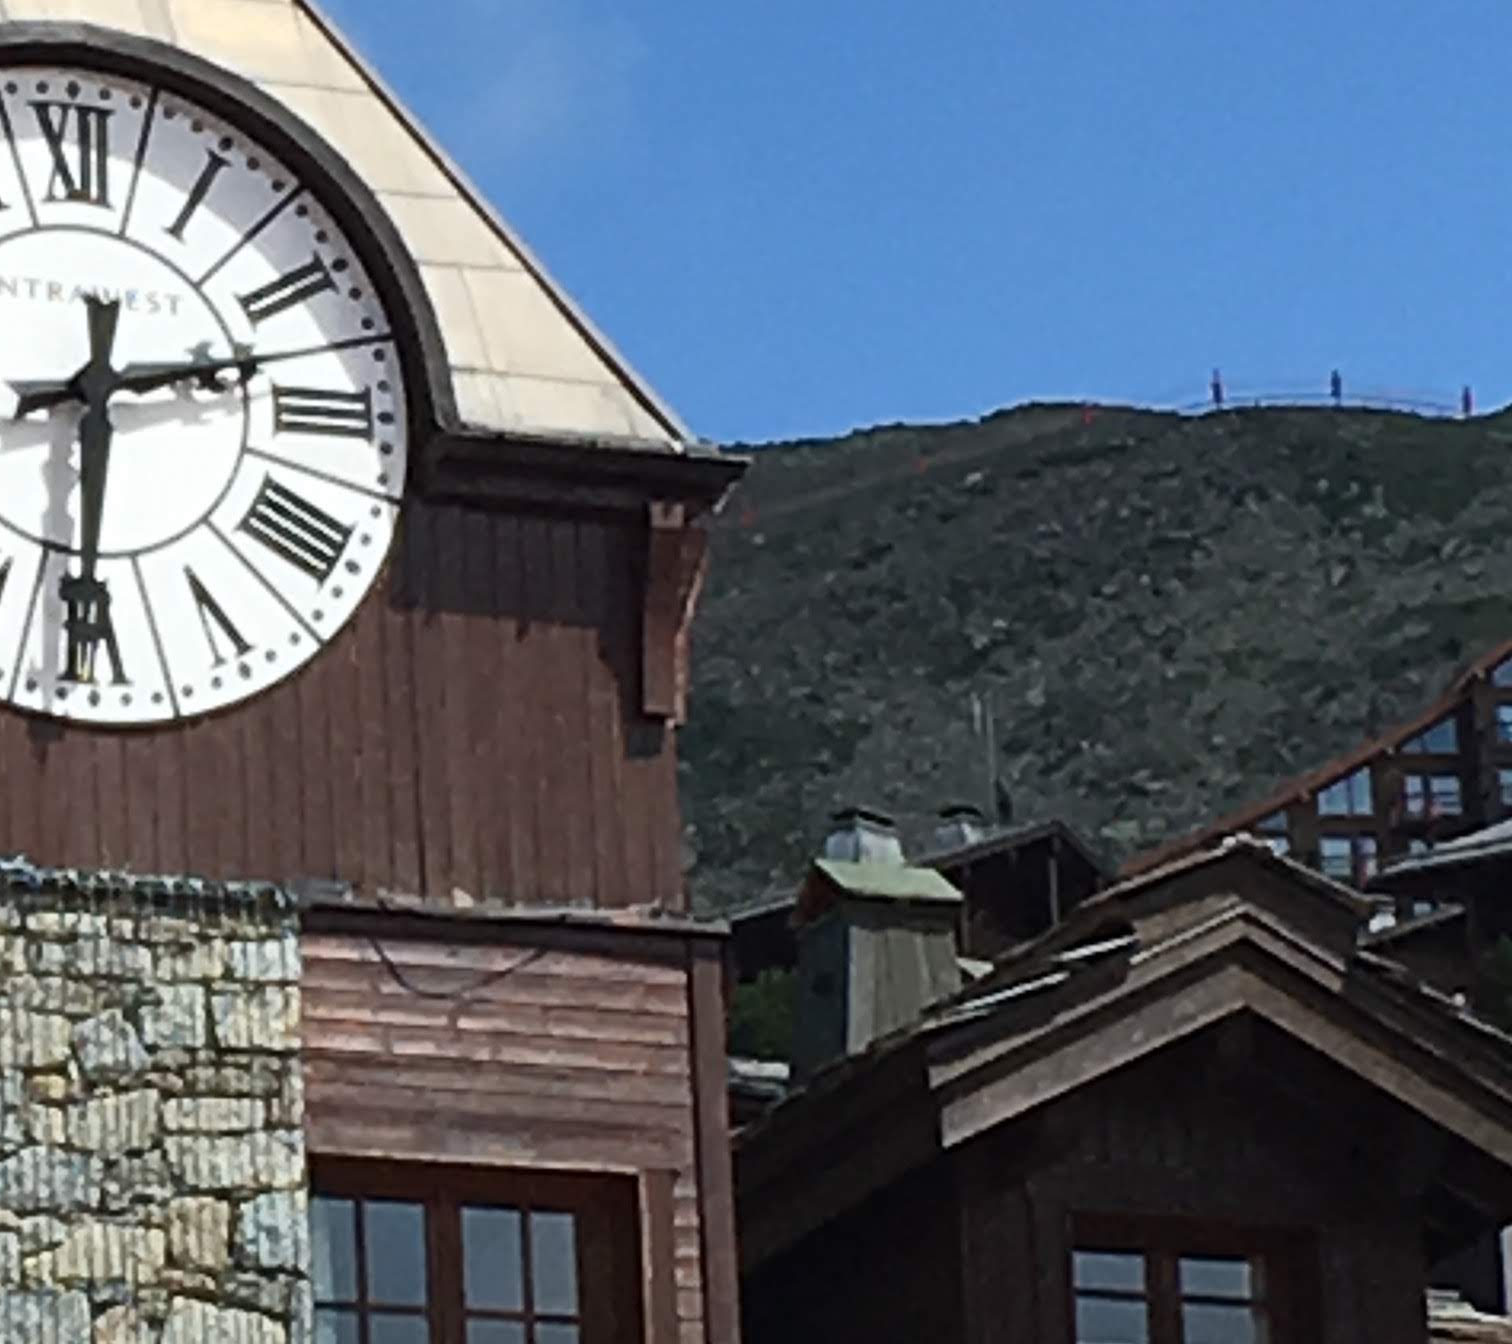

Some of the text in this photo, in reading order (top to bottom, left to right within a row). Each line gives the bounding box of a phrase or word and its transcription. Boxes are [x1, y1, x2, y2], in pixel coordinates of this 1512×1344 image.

[27, 101, 116, 211] XII
[164, 148, 232, 244] I
[234, 250, 340, 333] II
[270, 376, 375, 445] III
[184, 564, 256, 669] V
